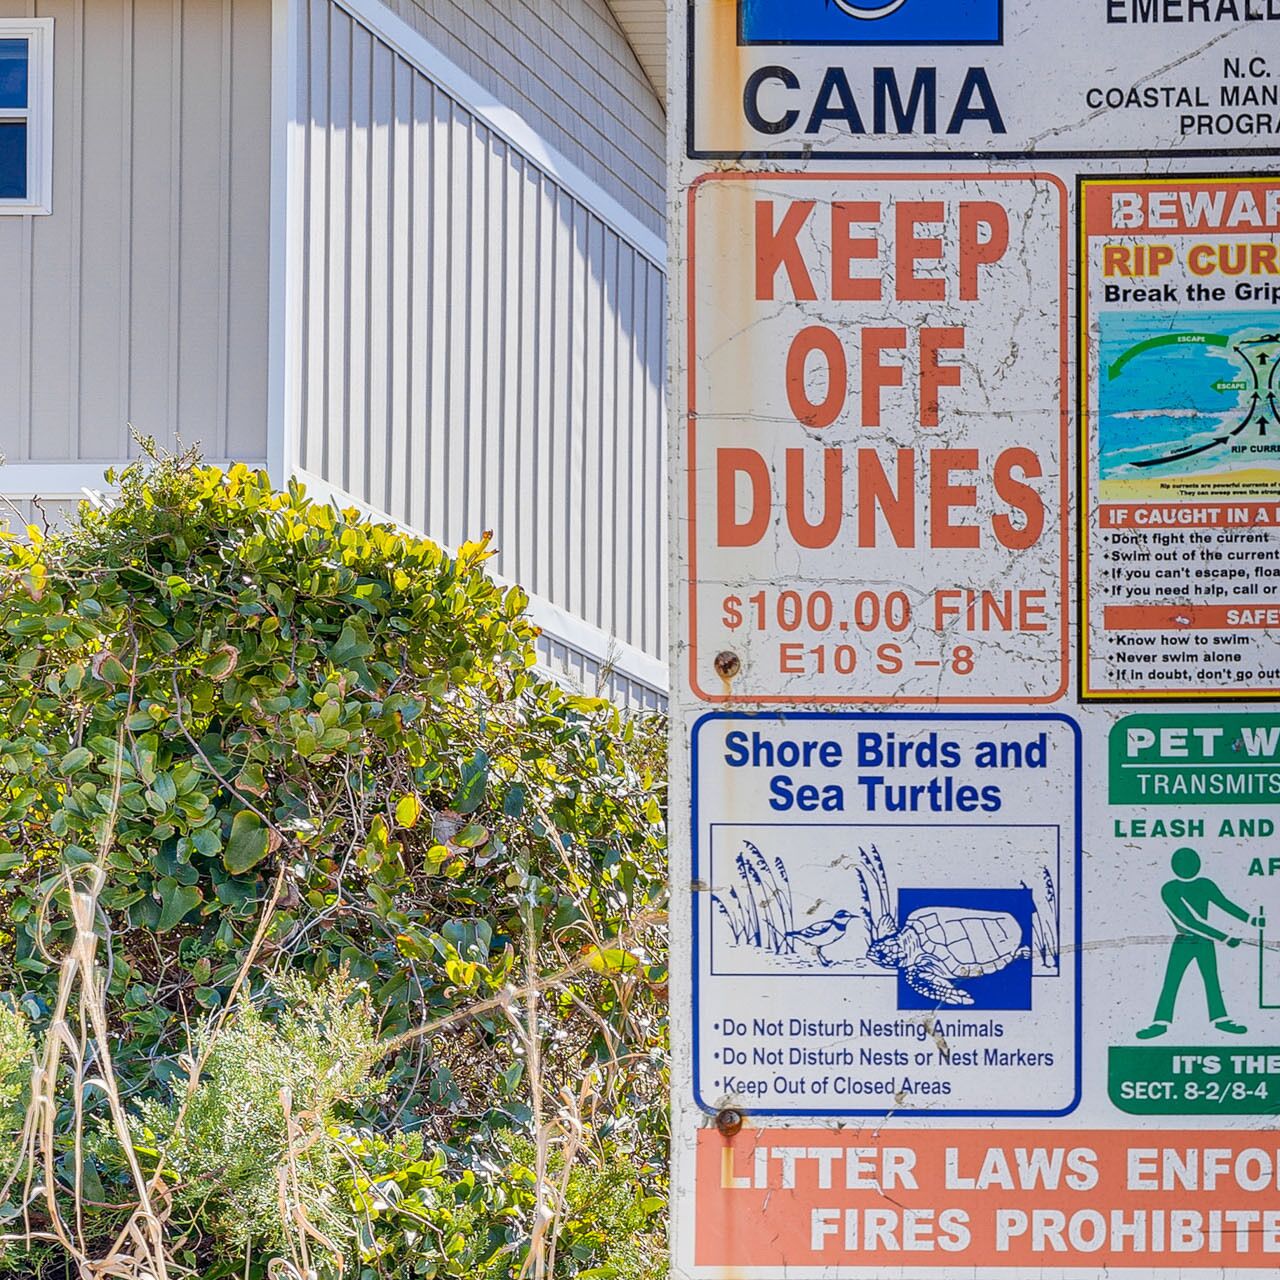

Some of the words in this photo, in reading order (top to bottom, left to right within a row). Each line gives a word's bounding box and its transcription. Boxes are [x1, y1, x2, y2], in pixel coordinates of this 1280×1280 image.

[1224, 57, 1271, 78] N.C.
[743, 65, 1007, 135] CAMA
[1087, 87, 1209, 108] COASTAL
[754, 200, 1010, 302] KEEP
[1103, 243, 1174, 277] RIP
[1104, 284, 1178, 302] Break
[1186, 283, 1226, 301] the
[1177, 335, 1206, 343] ESCAPE
[785, 325, 962, 429] OFF
[1217, 382, 1245, 390] ESCAPE
[1231, 445, 1247, 453] RIP
[716, 448, 1045, 549] DUNES
[1109, 508, 1127, 524] IF
[1134, 508, 1221, 524] CAUGHT
[1227, 508, 1249, 524] IN
[1255, 508, 1269, 523] A
[1112, 534, 1148, 544] Don't
[1153, 533, 1184, 546] fight
[1189, 533, 1212, 543] the
[1217, 533, 1269, 542] current
[1112, 551, 1150, 561] Swim
[1155, 551, 1177, 560] out
[1182, 550, 1196, 560] of
[1201, 551, 1222, 560] the
[1112, 568, 1121, 578] If
[1126, 569, 1150, 580] you
[1156, 568, 1190, 578] can't
[1195, 568, 1249, 579] escape,
[1112, 586, 1121, 595] If
[1126, 587, 1150, 598] you
[1156, 585, 1189, 595] need
[1233, 584, 1258, 594] call
[1263, 585, 1277, 594] or
[722, 590, 910, 633] $100.00
[934, 590, 1048, 631] FINE
[1116, 635, 1157, 645] Know
[1161, 635, 1190, 645] how
[1195, 635, 1208, 644] to
[1213, 634, 1249, 644] swim
[779, 643, 857, 674] E10
[1117, 653, 1157, 662] Never
[1162, 653, 1198, 662] swim
[1203, 652, 1241, 662] alone
[1117, 670, 1126, 680] If
[1131, 671, 1143, 679] in
[1148, 670, 1192, 681] doubt,
[1197, 669, 1231, 678] don't
[1237, 670, 1253, 681] go
[1258, 669, 1280, 678] out
[724, 731, 842, 768] Shore
[857, 732, 961, 768] Birds
[975, 732, 1047, 768] and
[1127, 728, 1223, 757] PET
[769, 775, 844, 812] Sea
[858, 775, 1001, 812] Turtles
[1114, 819, 1204, 838] LEASH
[1218, 818, 1274, 837] AND
[723, 1020, 747, 1036] Do
[753, 1020, 784, 1036] Not
[790, 1019, 854, 1036] Disturb
[859, 1020, 927, 1040] Nesting
[932, 1020, 1004, 1037] Animals
[723, 1049, 747, 1065] Do
[753, 1048, 784, 1065] Not
[789, 1048, 854, 1065] Disturb
[859, 1049, 908, 1066] Nests
[915, 1053, 933, 1066] or
[939, 1049, 978, 1066] Nest
[983, 1050, 1054, 1066] Markers
[1173, 1055, 1221, 1074] IT'S
[723, 1078, 767, 1097] Keep
[773, 1077, 806, 1094] Out
[811, 1077, 829, 1094] of
[834, 1077, 895, 1094] Closed
[901, 1078, 951, 1095] Areas
[1120, 1082, 1178, 1099] SECT.
[1184, 1081, 1268, 1103] 8-2/8-4
[720, 1147, 917, 1191] LITTER
[944, 1147, 1099, 1191] LAWS
[810, 1208, 971, 1252] FIRES
